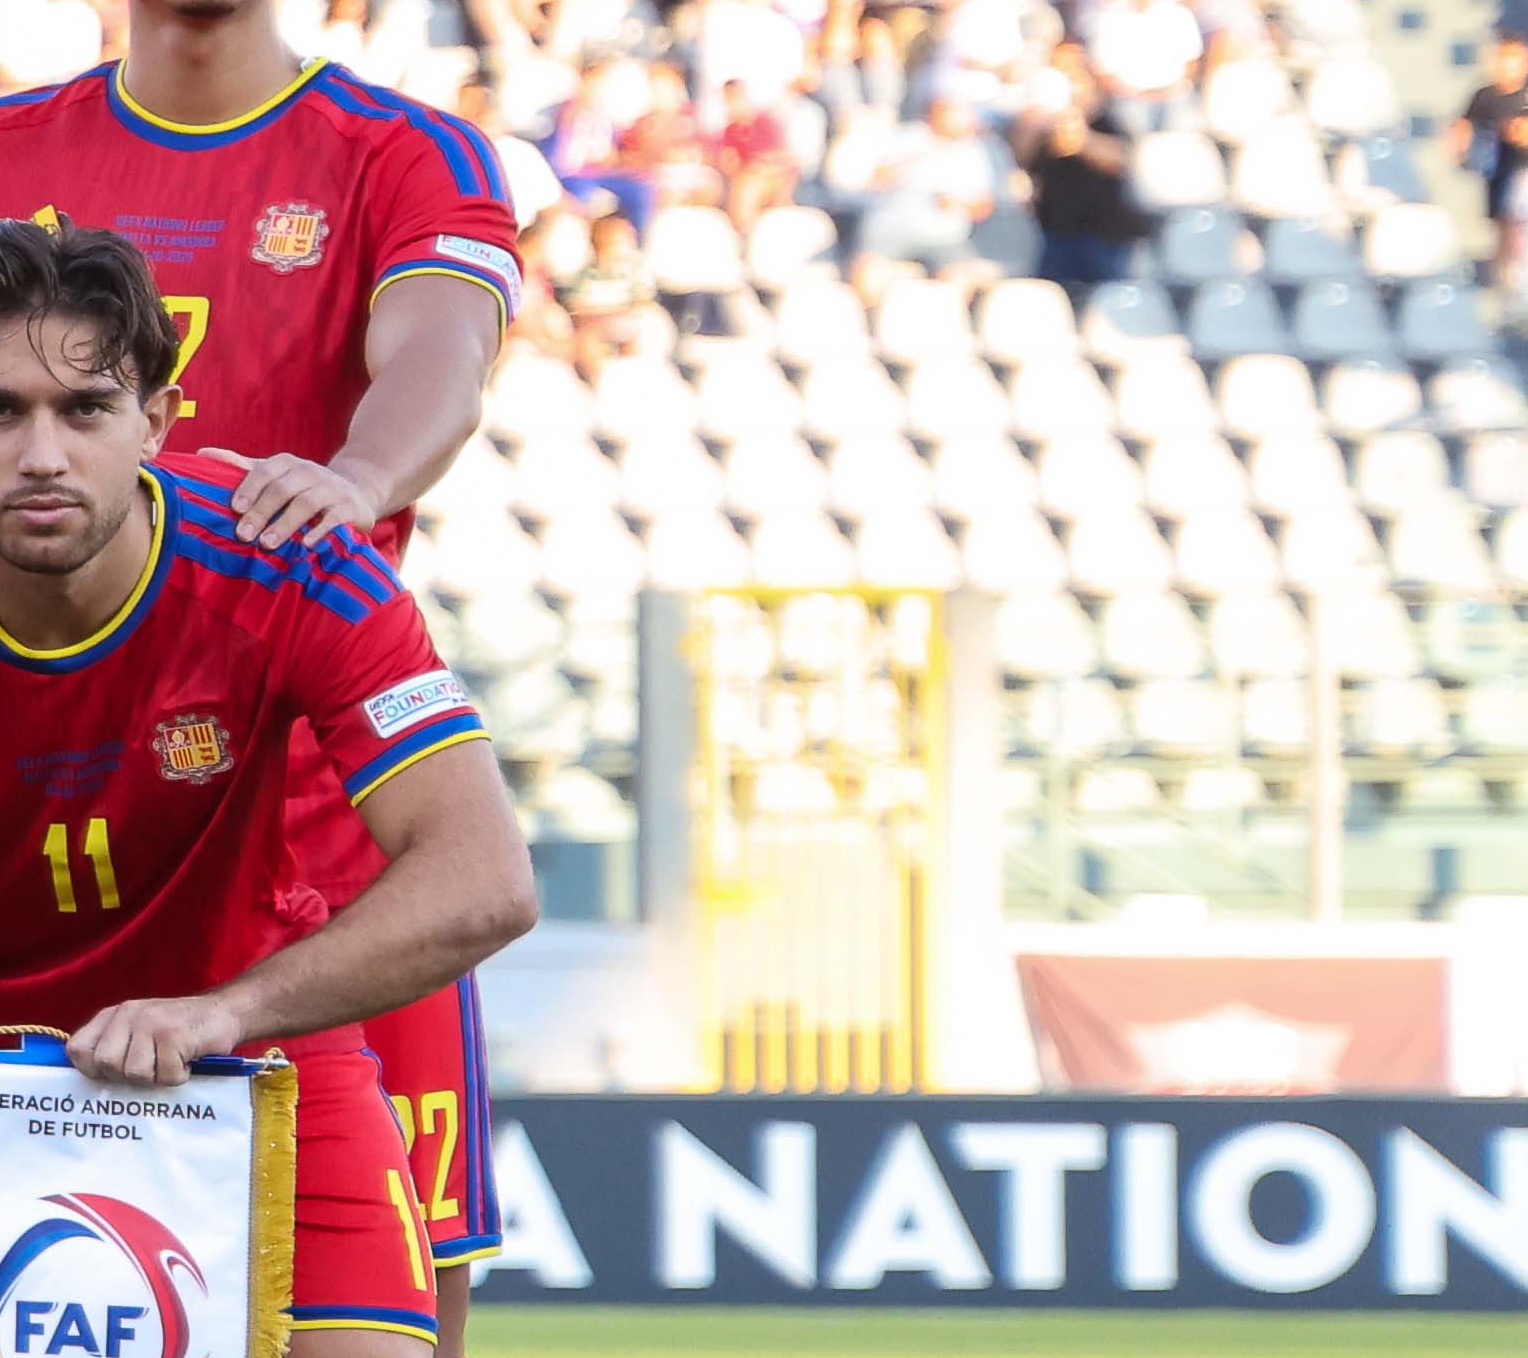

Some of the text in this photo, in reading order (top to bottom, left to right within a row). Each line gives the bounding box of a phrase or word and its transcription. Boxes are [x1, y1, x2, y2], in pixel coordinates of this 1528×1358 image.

[42, 818, 120, 913] 11
[28, 1119, 143, 1142] DE FUTBOL
[81, 1098, 217, 1121] ANDORRANA
[654, 1120, 1528, 1296] NATION
[14, 1300, 149, 1358] FAF
